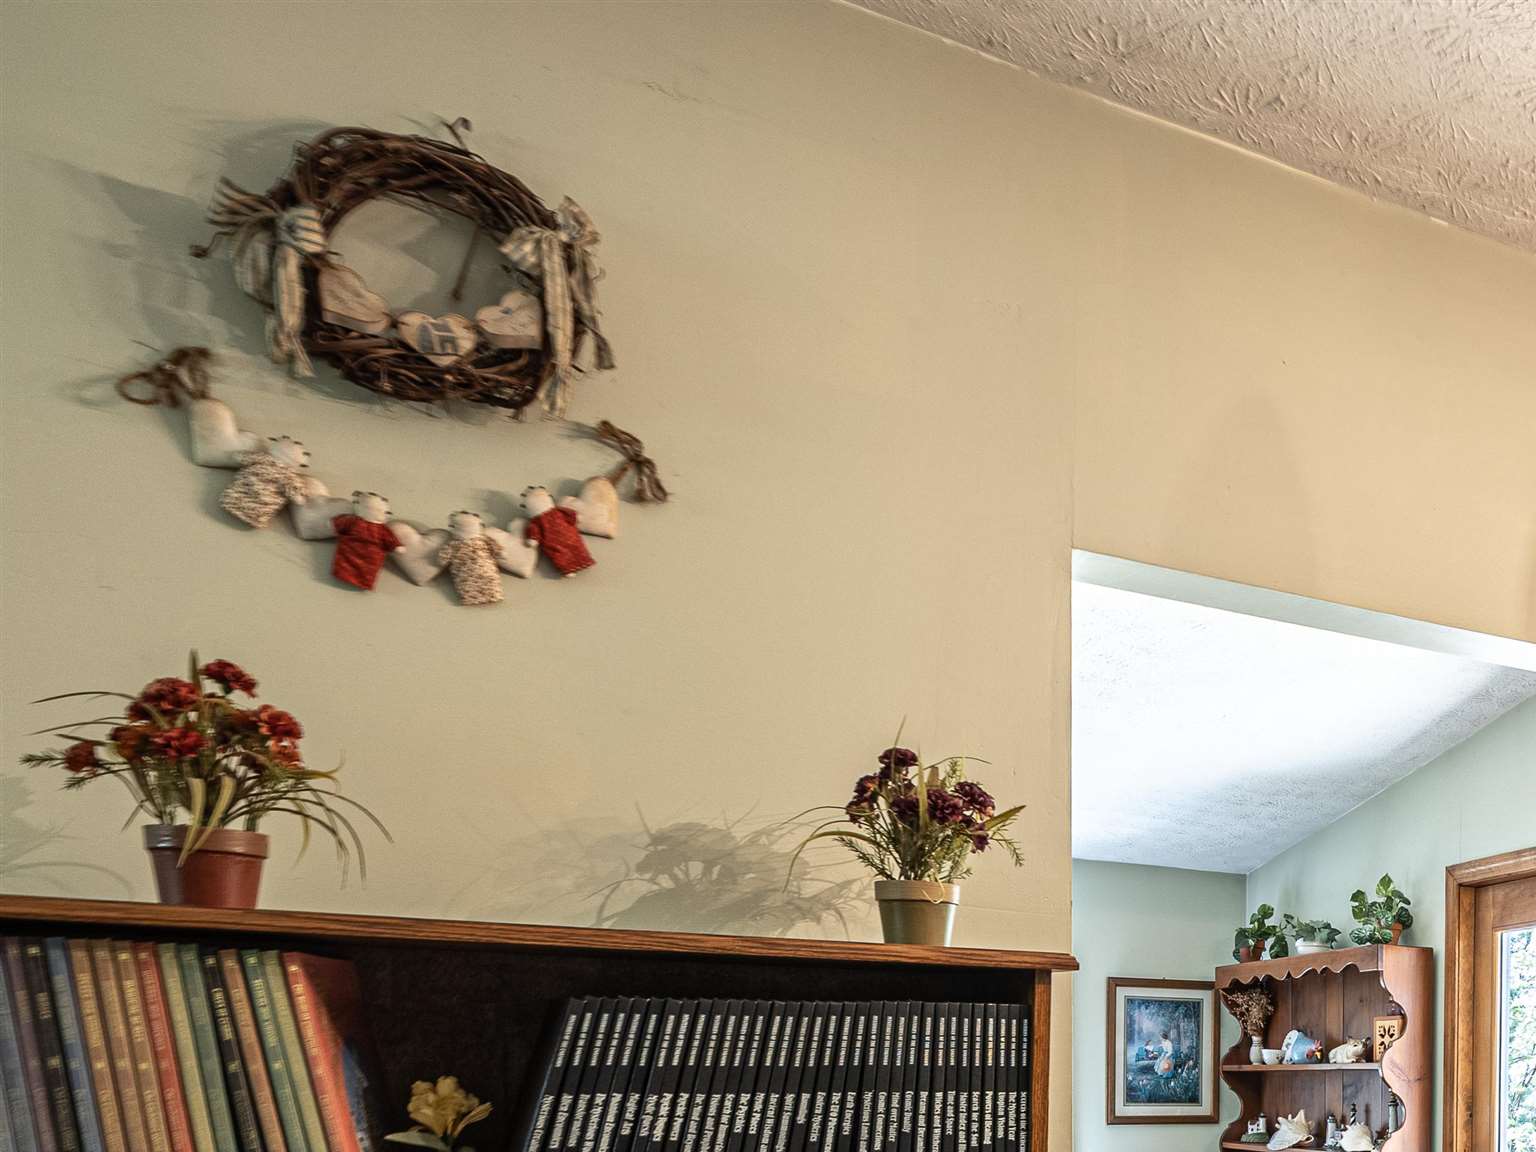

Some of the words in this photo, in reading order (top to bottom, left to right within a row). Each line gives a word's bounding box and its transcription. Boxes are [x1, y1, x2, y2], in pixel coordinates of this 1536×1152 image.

[559, 1094, 573, 1113] Alien
[643, 1094, 658, 1116] Mystic
[659, 1093, 673, 1118] Psychic
[675, 1093, 689, 1118] Psychic
[708, 1094, 721, 1116] Visions
[722, 1093, 735, 1115] Search
[753, 1093, 765, 1114] Mystic
[767, 1093, 779, 1117] Ancient
[784, 1094, 795, 1111] Spirit
[815, 1092, 826, 1114] Eastern
[846, 1092, 856, 1108] Earth
[862, 1090, 874, 1122] Mysterious
[878, 1092, 887, 1115] Cosmic
[891, 1092, 900, 1109] Mind
[904, 1091, 914, 1113] Cosmic
[919, 1091, 928, 1114] Dreams
[934, 1092, 943, 1116] Witches
[947, 1091, 955, 1106] Time
[960, 1092, 968, 1112] Master
[972, 1092, 980, 1111] Search
[985, 1091, 993, 1115] Powers
[536, 1095, 554, 1128] Mysterious
[568, 1094, 590, 1147] Transformations
[691, 1105, 702, 1122] Mind
[734, 1105, 748, 1132] Psychics
[842, 1110, 853, 1135] Energies
[902, 1112, 912, 1133] Duality
[959, 1113, 967, 1130] Index
[1008, 1103, 1016, 1126] Mystical
[585, 1106, 603, 1140] Mysterious
[621, 1121, 633, 1135] Arts
[670, 1117, 683, 1140] Powers
[749, 1113, 761, 1134] Places
[761, 1119, 774, 1145] Wisdom
[776, 1112, 792, 1152] Summonings
[810, 1115, 822, 1142] Mysteries
[860, 1123, 870, 1140] Lands
[874, 1114, 885, 1150] Connections
[889, 1122, 898, 1142] Matter
[946, 1118, 954, 1135] Space
[983, 1121, 992, 1144] Healing
[997, 1117, 1005, 1138] Visions
[1008, 1127, 1016, 1141] Year
[971, 1133, 979, 1146] Soul
